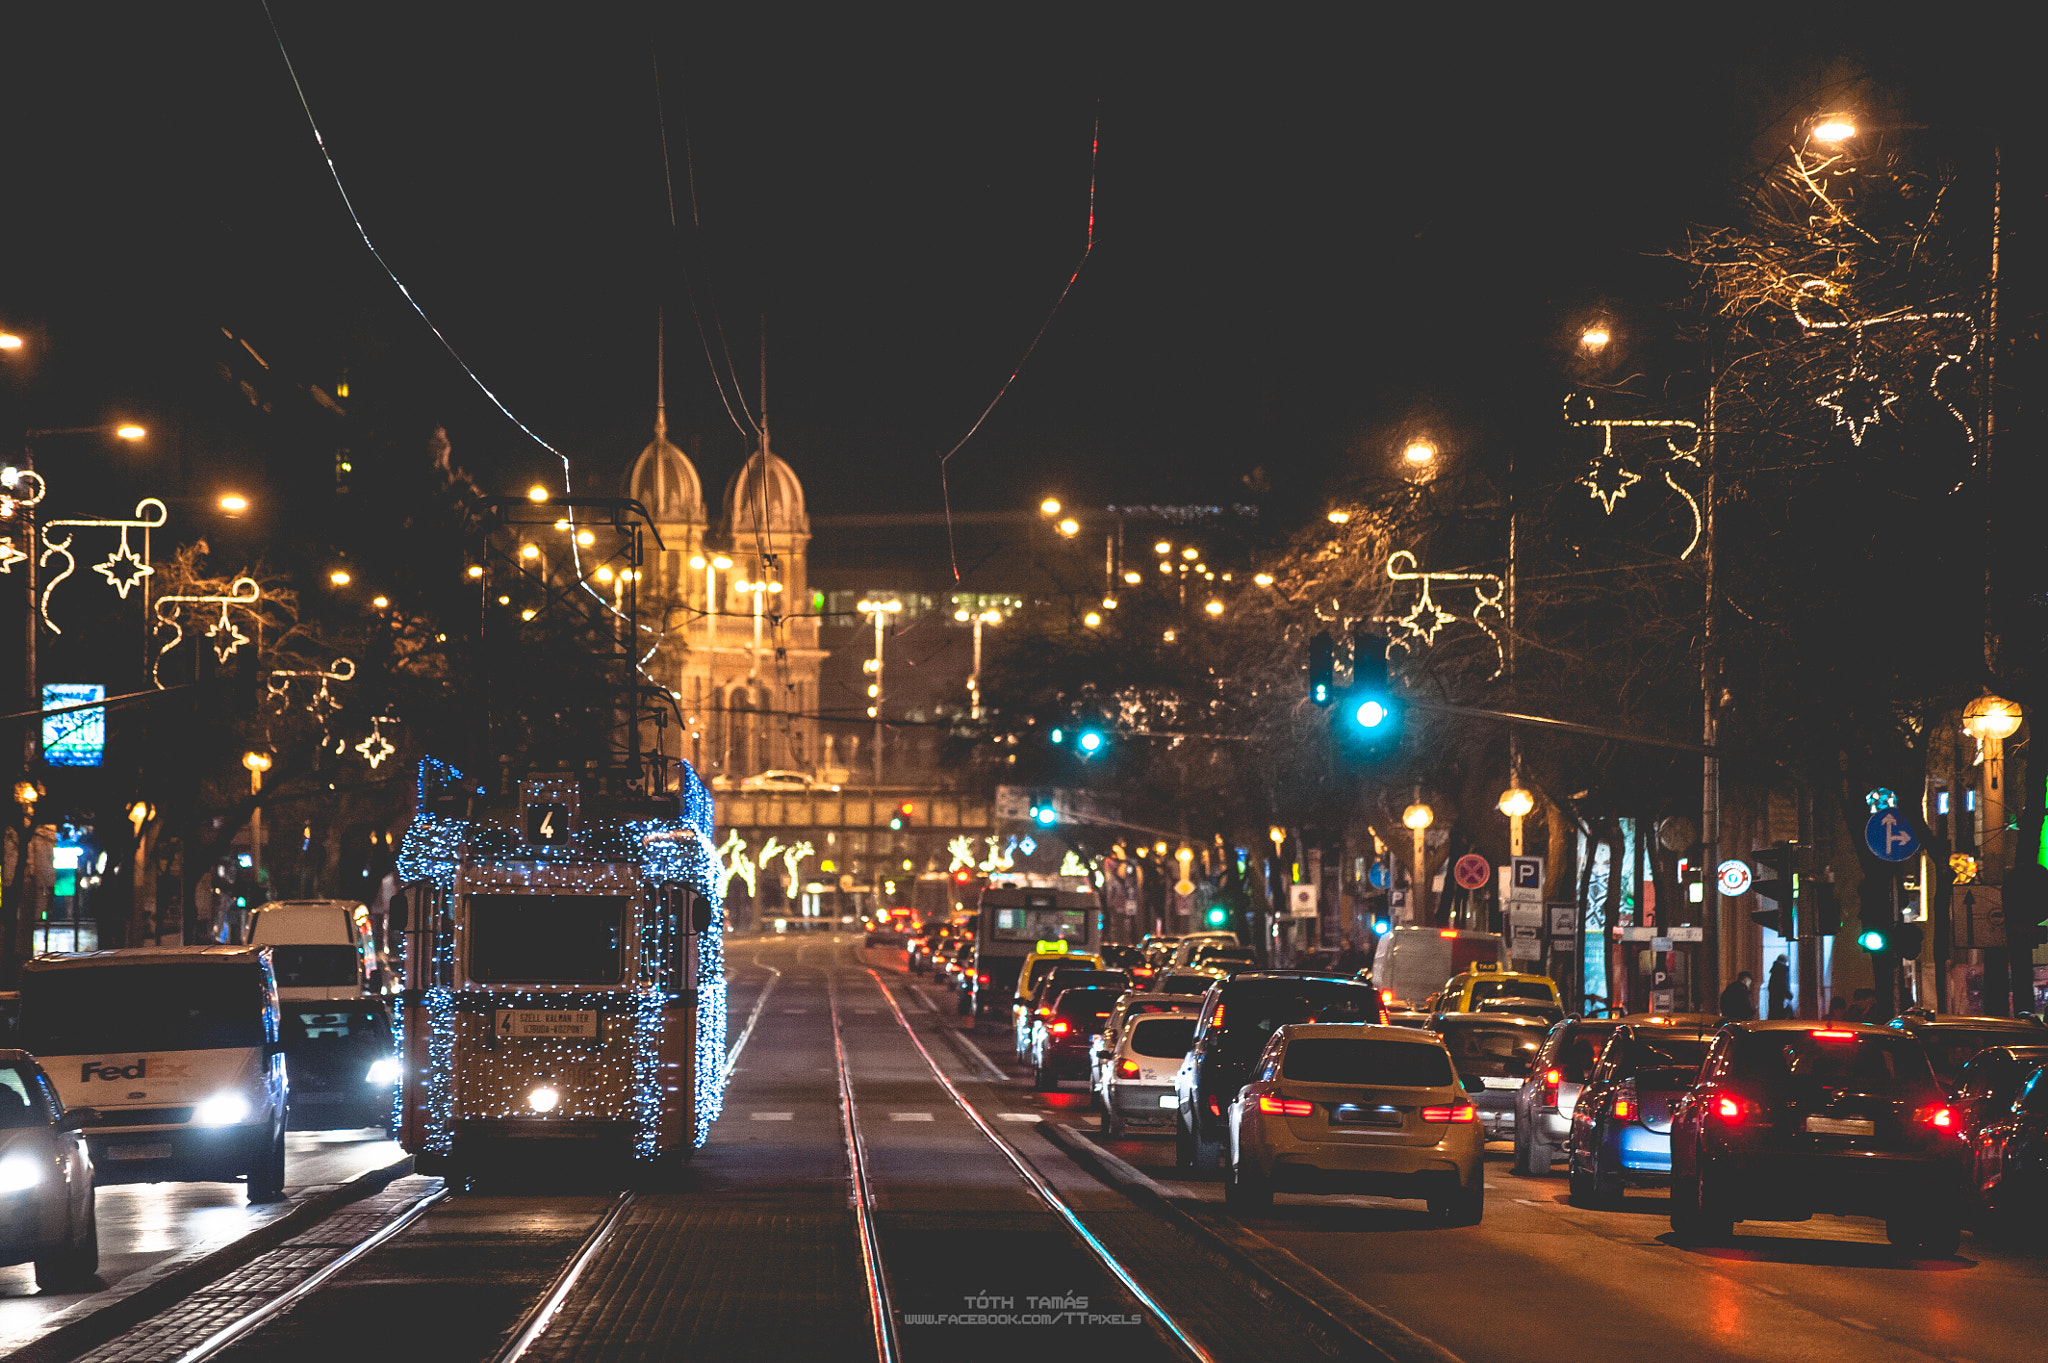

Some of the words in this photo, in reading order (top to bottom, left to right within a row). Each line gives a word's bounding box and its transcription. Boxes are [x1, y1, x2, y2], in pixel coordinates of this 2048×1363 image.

[540, 811, 554, 839] 4
[1520, 864, 1535, 884] P
[1391, 892, 1403, 905] P
[1655, 972, 1666, 985] P
[502, 1013, 511, 1032] 4
[81, 1058, 188, 1083] FedEx
